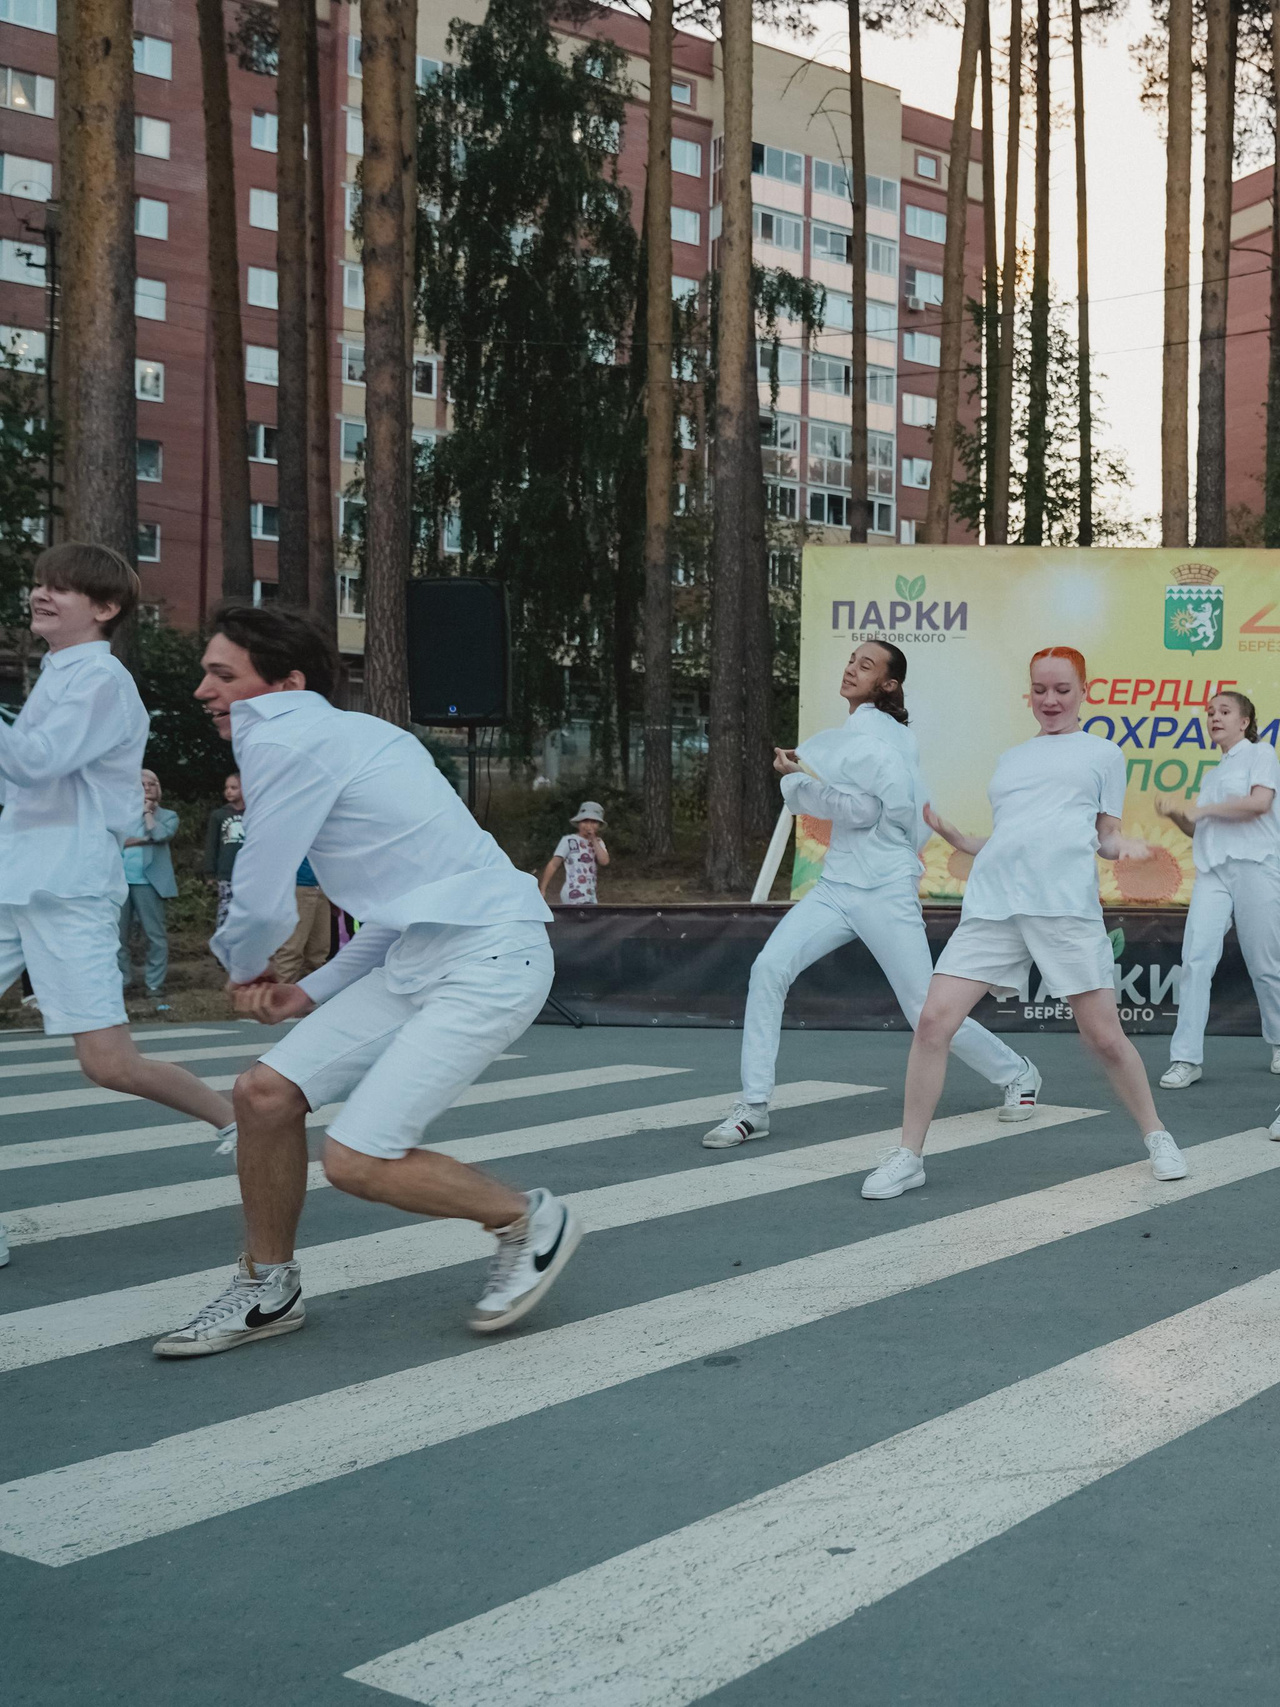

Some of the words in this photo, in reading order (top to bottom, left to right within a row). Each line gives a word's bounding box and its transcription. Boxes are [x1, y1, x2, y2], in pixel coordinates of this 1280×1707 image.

[832, 600, 968, 631] ПАРКИ
[851, 630, 946, 643] БЕРЁЗОВСКОГО
[1078, 715, 1280, 750] ОХРАИ
[1024, 1003, 1155, 1022] БЕРЁЗОГО
